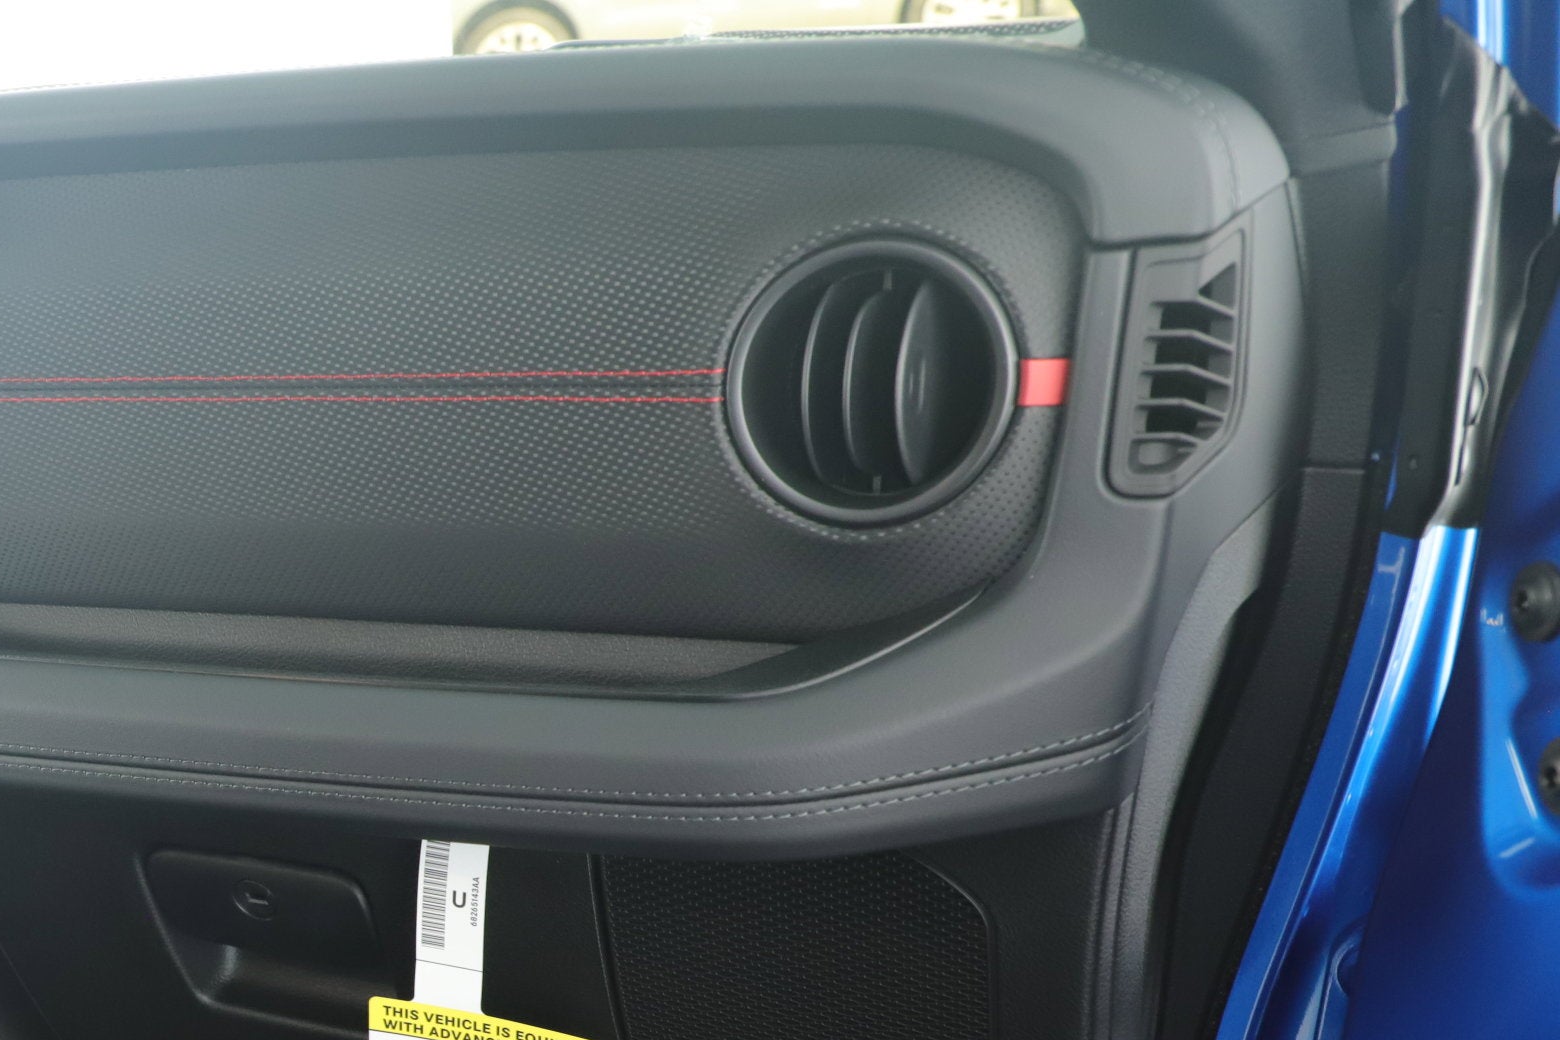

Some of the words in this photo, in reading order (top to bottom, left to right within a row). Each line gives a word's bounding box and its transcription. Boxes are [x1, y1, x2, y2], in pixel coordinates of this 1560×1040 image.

[452, 890, 466, 908] U
[383, 1005, 419, 1020] THIS
[424, 1012, 491, 1034] VEHICLE
[496, 1026, 510, 1038] IS
[383, 1018, 424, 1034] WITH
